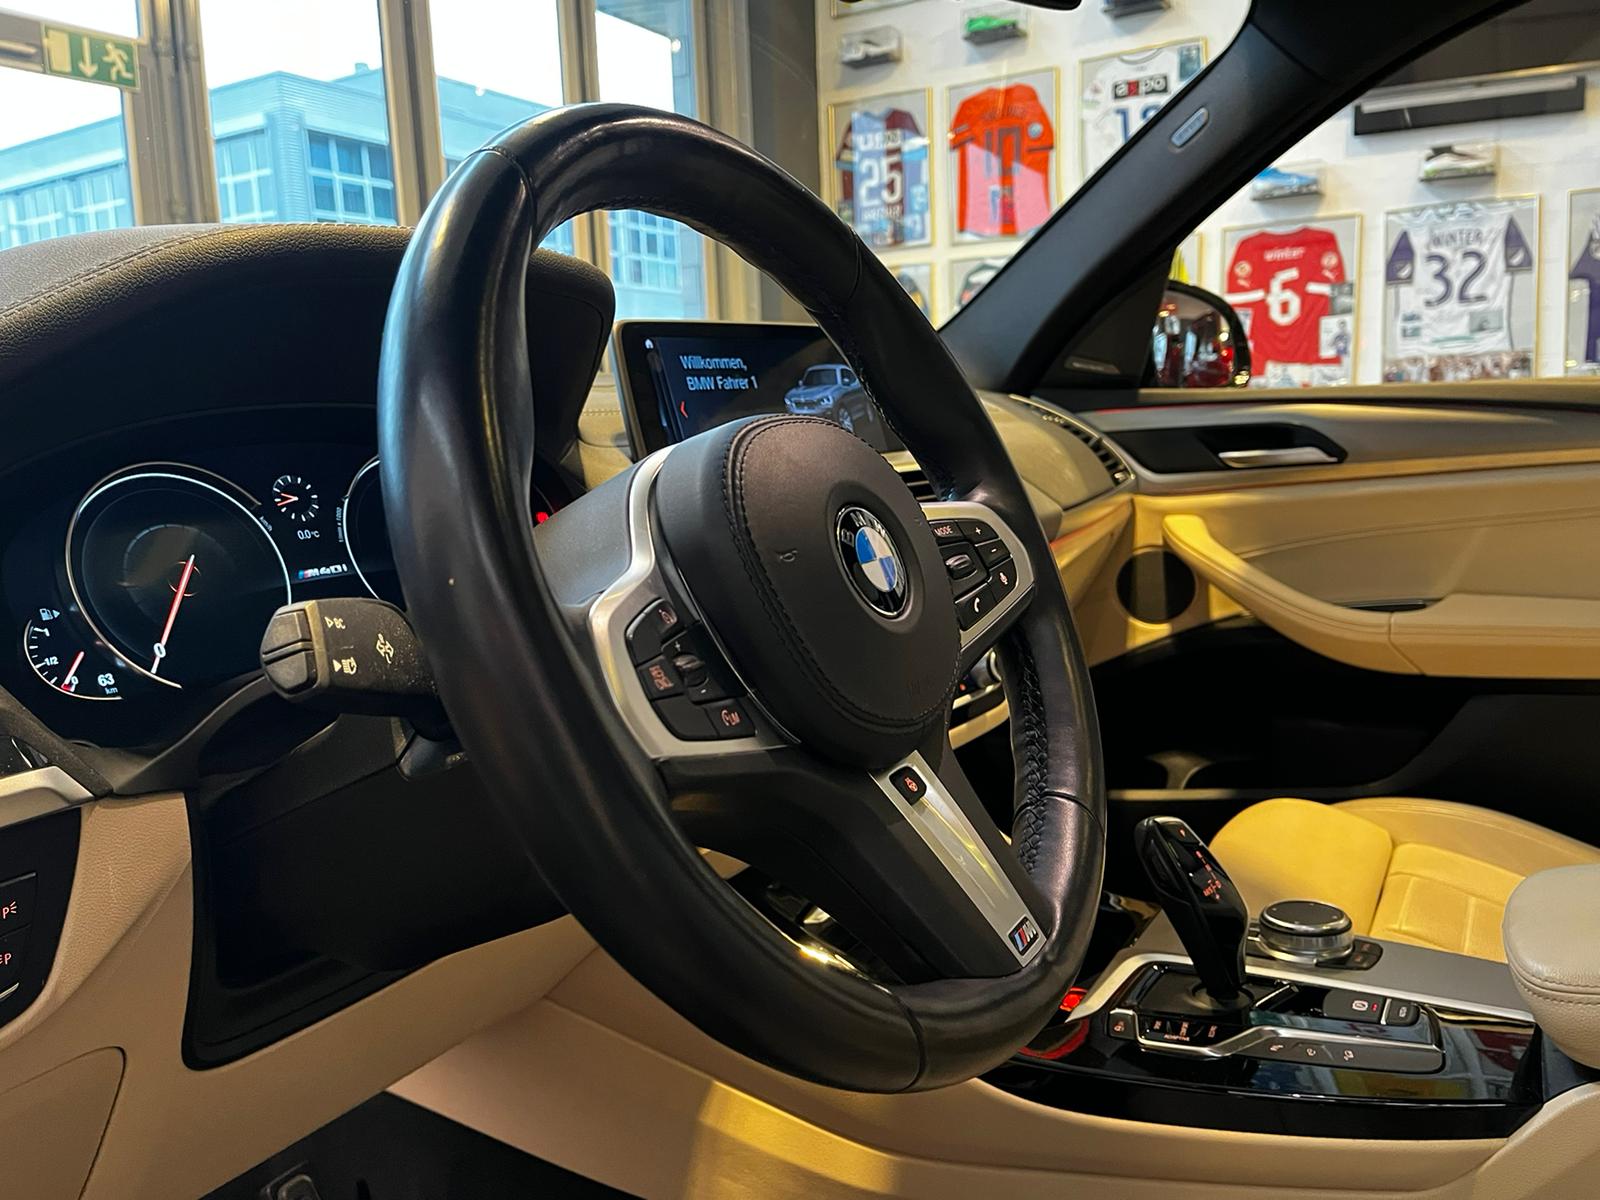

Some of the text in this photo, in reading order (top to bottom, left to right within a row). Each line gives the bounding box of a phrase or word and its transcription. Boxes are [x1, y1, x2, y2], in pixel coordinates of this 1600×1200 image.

[984, 126, 1022, 178] 10
[859, 153, 903, 206] 25
[1431, 228, 1483, 247] WINTER
[1264, 246, 1306, 262] winter
[1424, 251, 1487, 307] 32
[1267, 267, 1300, 327] 6
[679, 355, 748, 371] Willkommen,
[686, 375, 758, 391] BMW Fahrer 1
[153, 642, 167, 659] 0
[97, 672, 116, 687] 63
[105, 687, 119, 696] km
